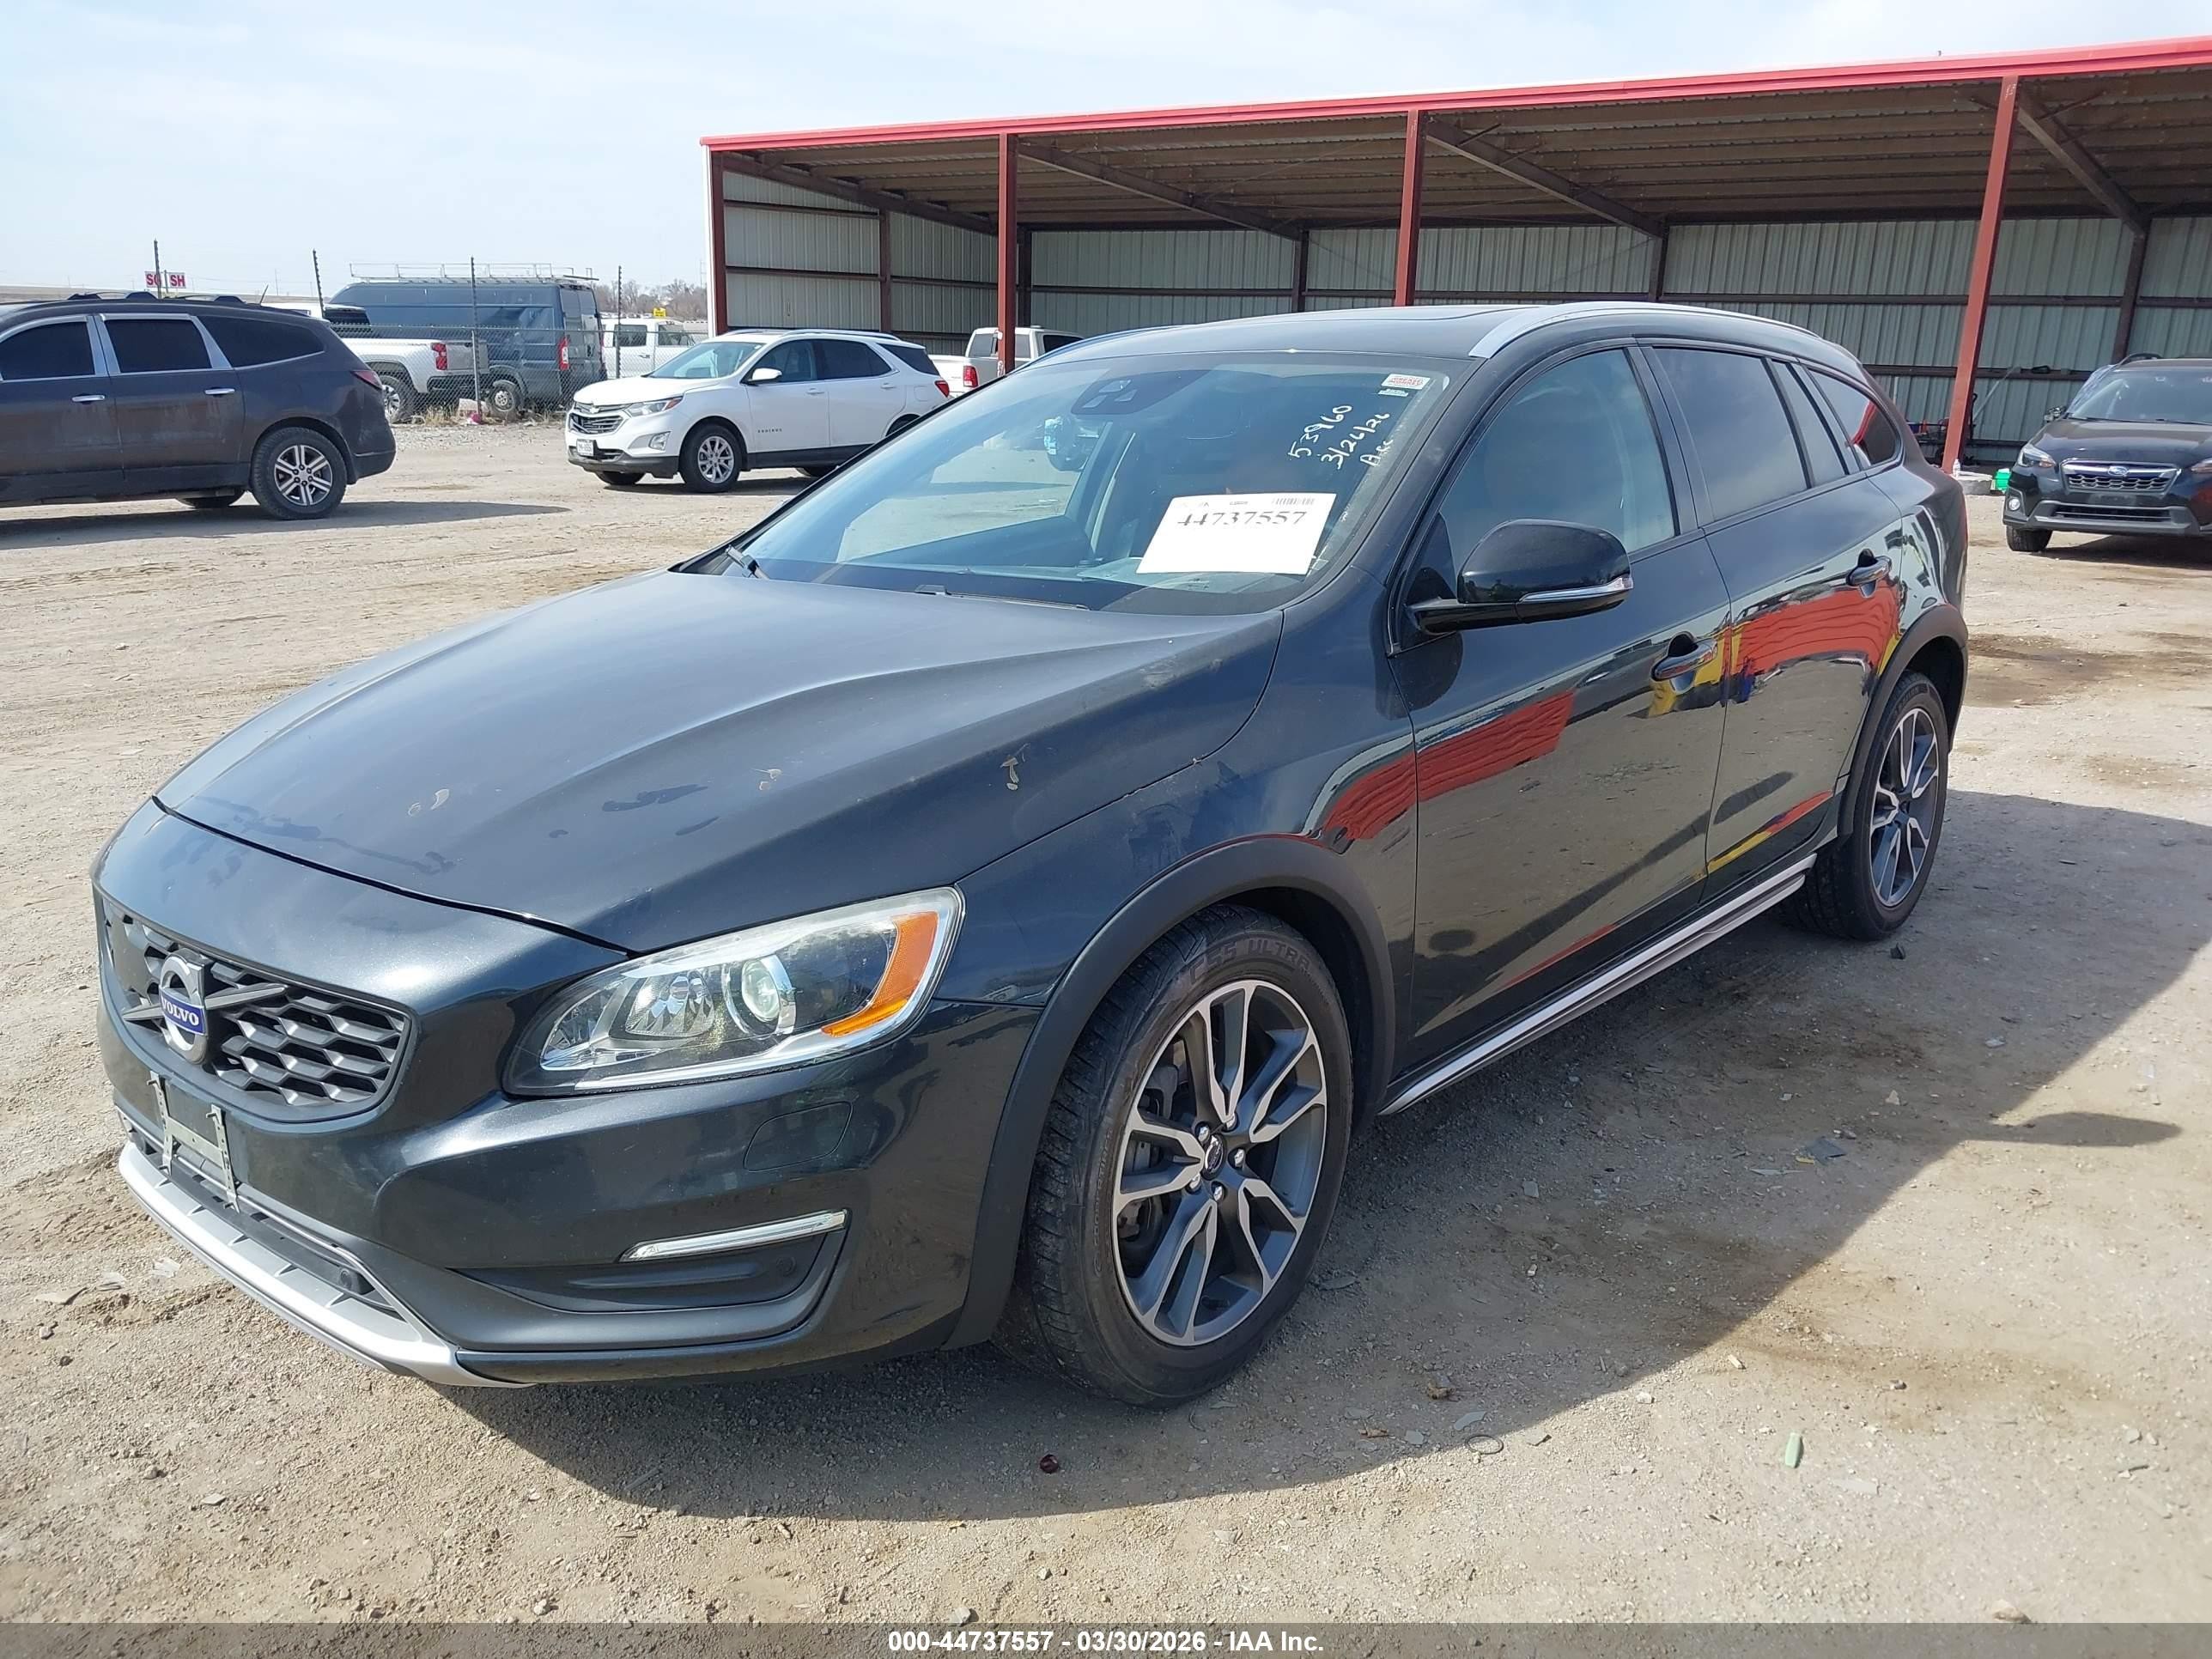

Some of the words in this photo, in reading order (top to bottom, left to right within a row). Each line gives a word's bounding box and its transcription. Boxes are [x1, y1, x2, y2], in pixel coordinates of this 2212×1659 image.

[1177, 510, 1307, 526] 44737557
[1247, 939, 1310, 969] ULTRA
[161, 995, 199, 1026] VOLVO
